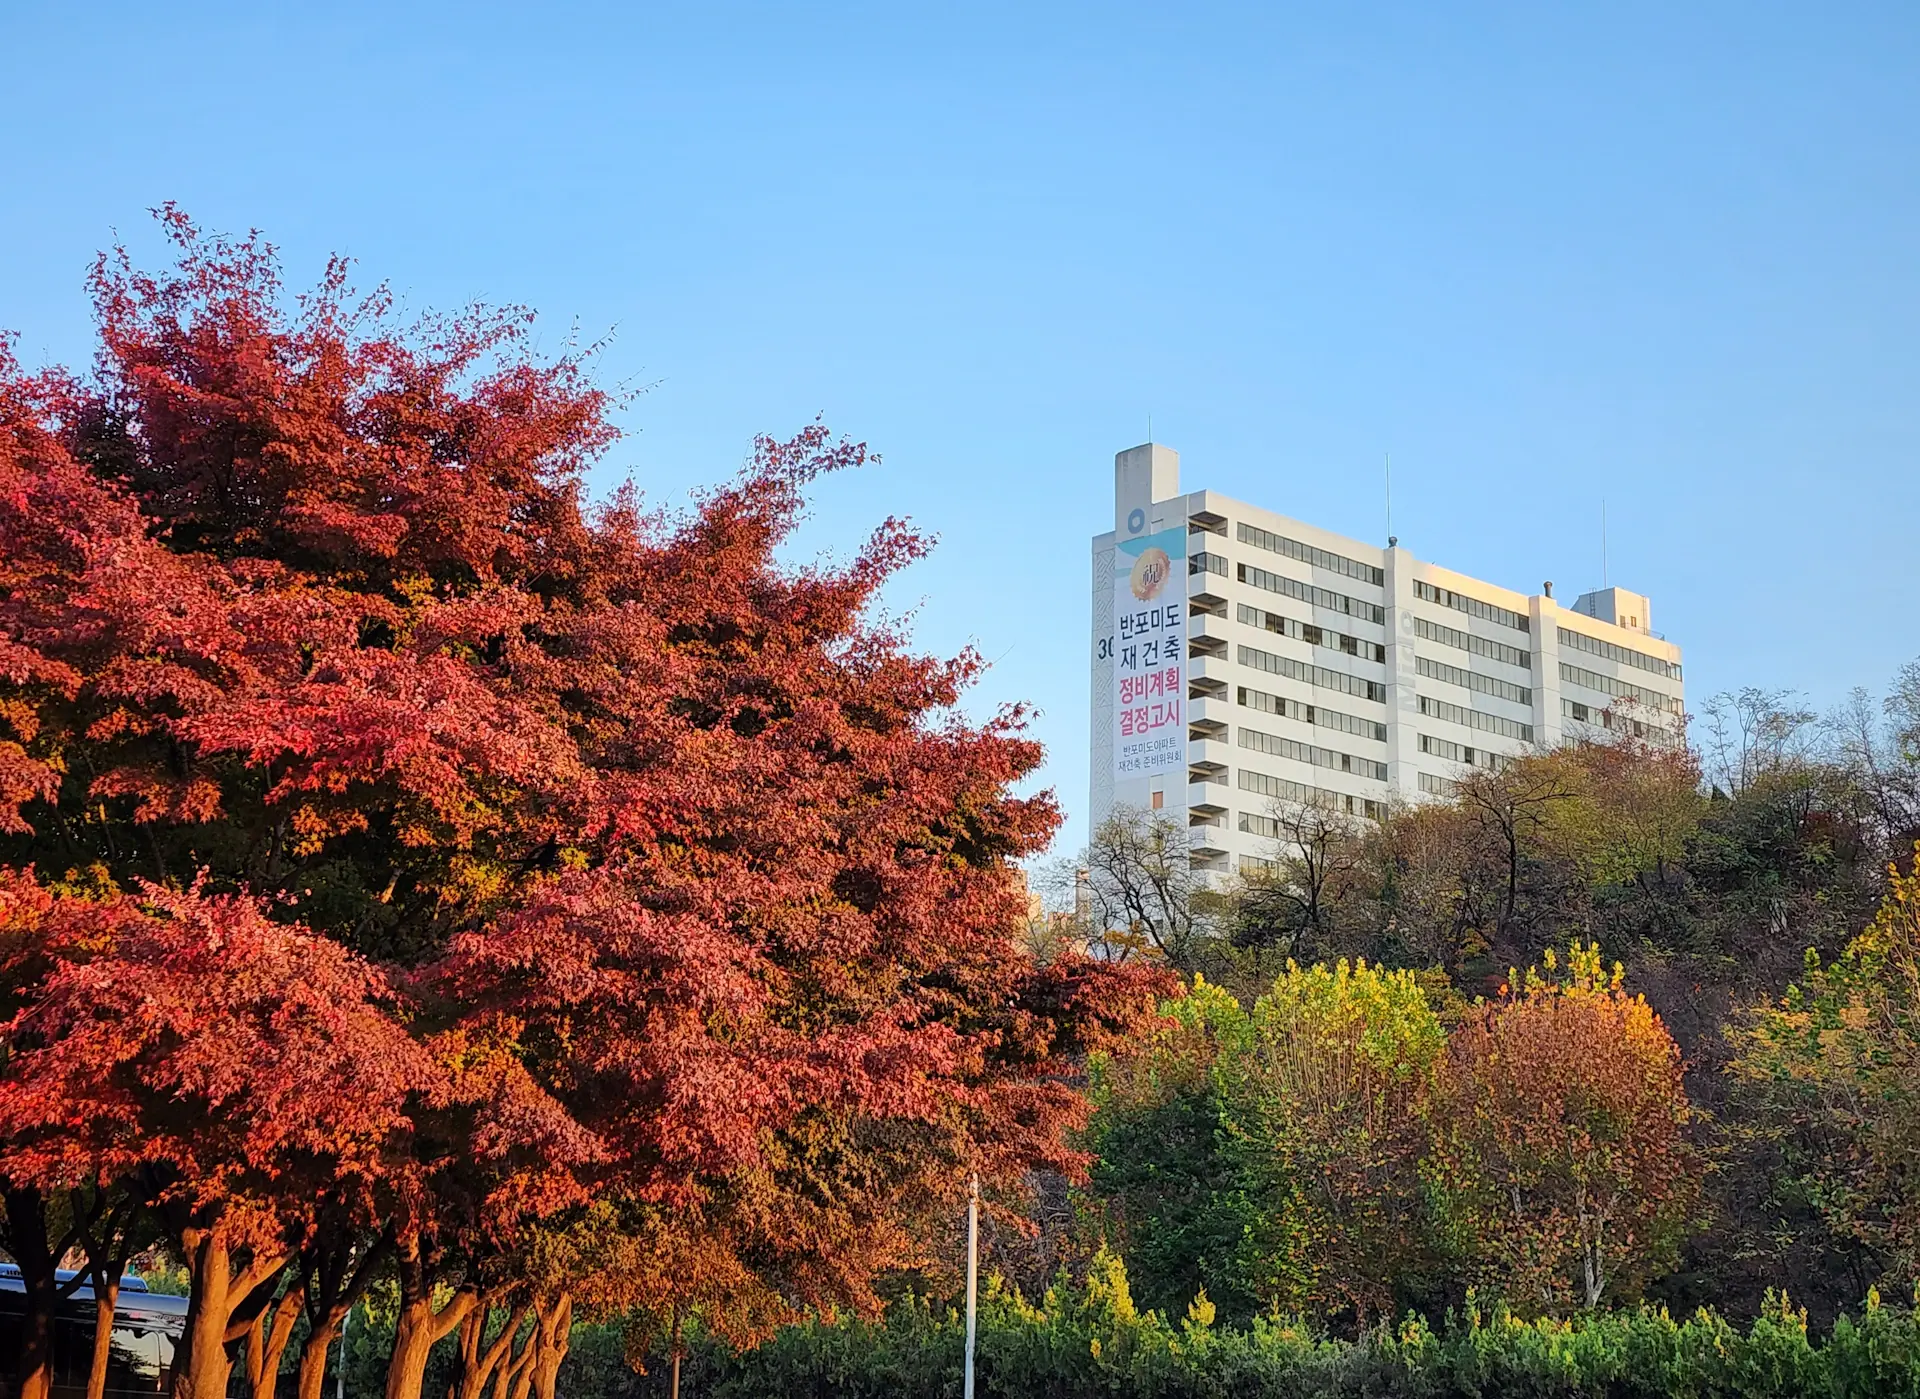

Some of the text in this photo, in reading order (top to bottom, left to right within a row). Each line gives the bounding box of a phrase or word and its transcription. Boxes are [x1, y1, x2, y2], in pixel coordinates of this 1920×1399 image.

[1142, 563, 1160, 586] 祝
[1120, 604, 1181, 641] 반포미도
[1119, 666, 1180, 705] 정비계획
[1119, 699, 1180, 737] 결정고시
[1118, 750, 1182, 772] 재건축 준비위원회
[1123, 737, 1177, 758] 반포미도아파트
